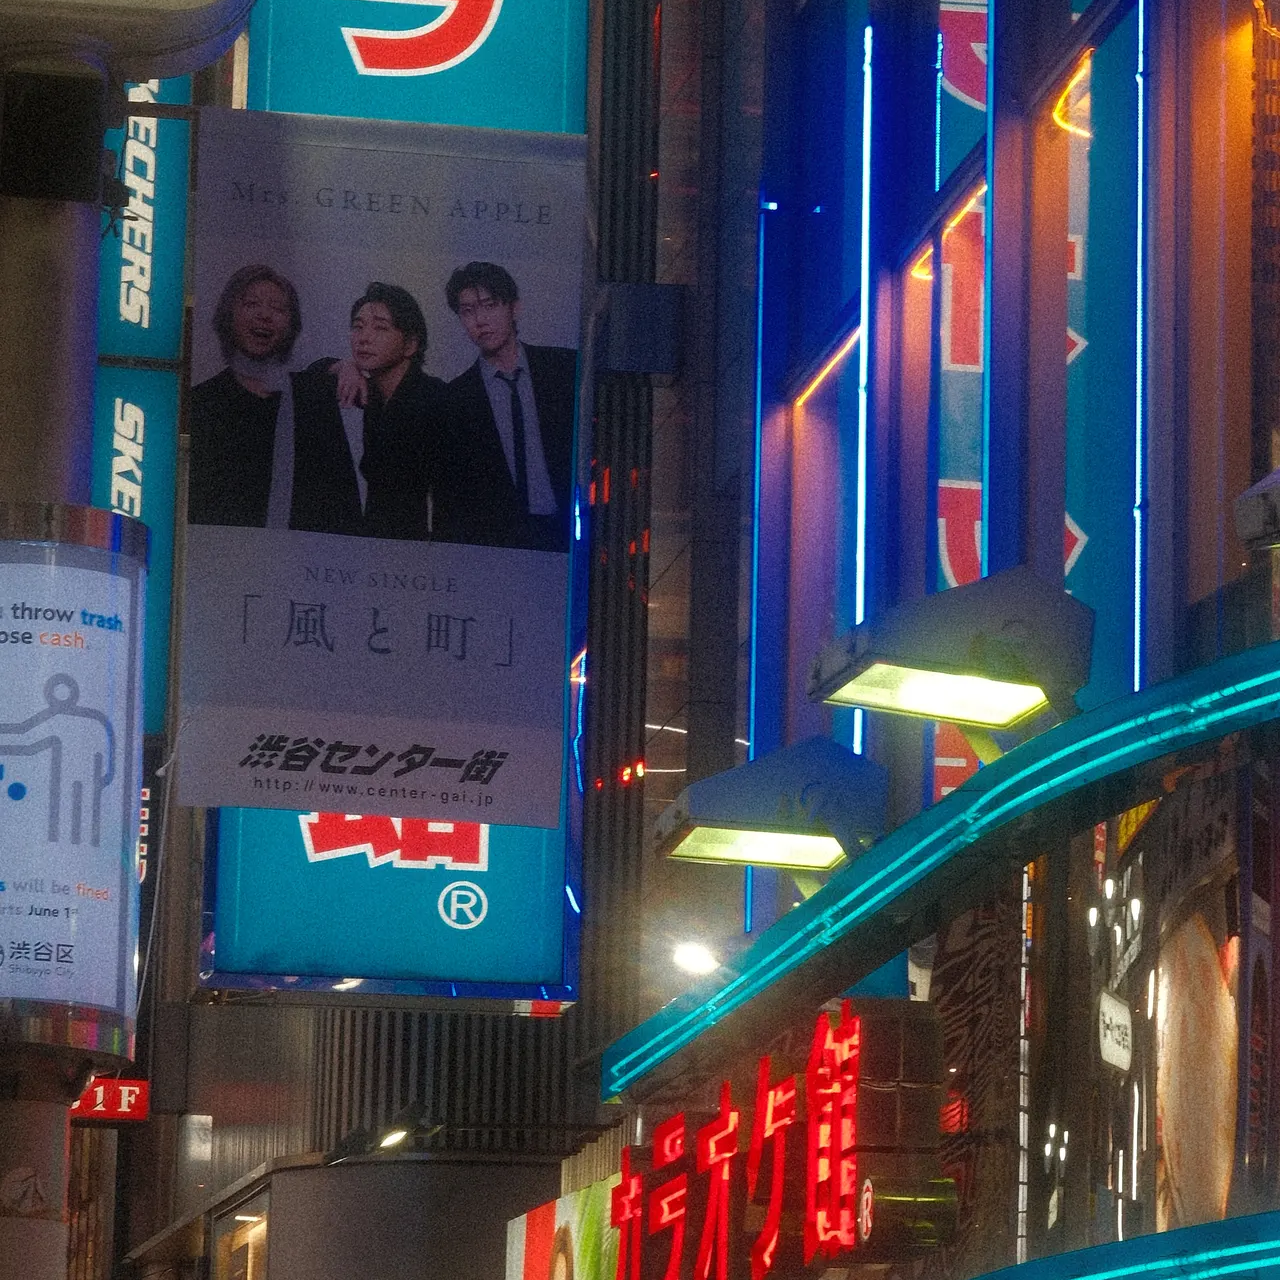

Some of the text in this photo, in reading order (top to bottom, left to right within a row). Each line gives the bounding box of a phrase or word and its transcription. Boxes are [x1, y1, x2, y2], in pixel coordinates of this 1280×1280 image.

[315, 186, 432, 217] GREEN
[448, 197, 552, 226] APPLE
[304, 566, 458, 593] NEW SINGLE
[11, 601, 75, 623] throw
[238, 733, 510, 785] 渋谷センター街
[51, 880, 71, 896] be
[28, 904, 60, 919] June
[9, 940, 75, 964] 渋谷区
[9, 964, 52, 978] Shibuya
